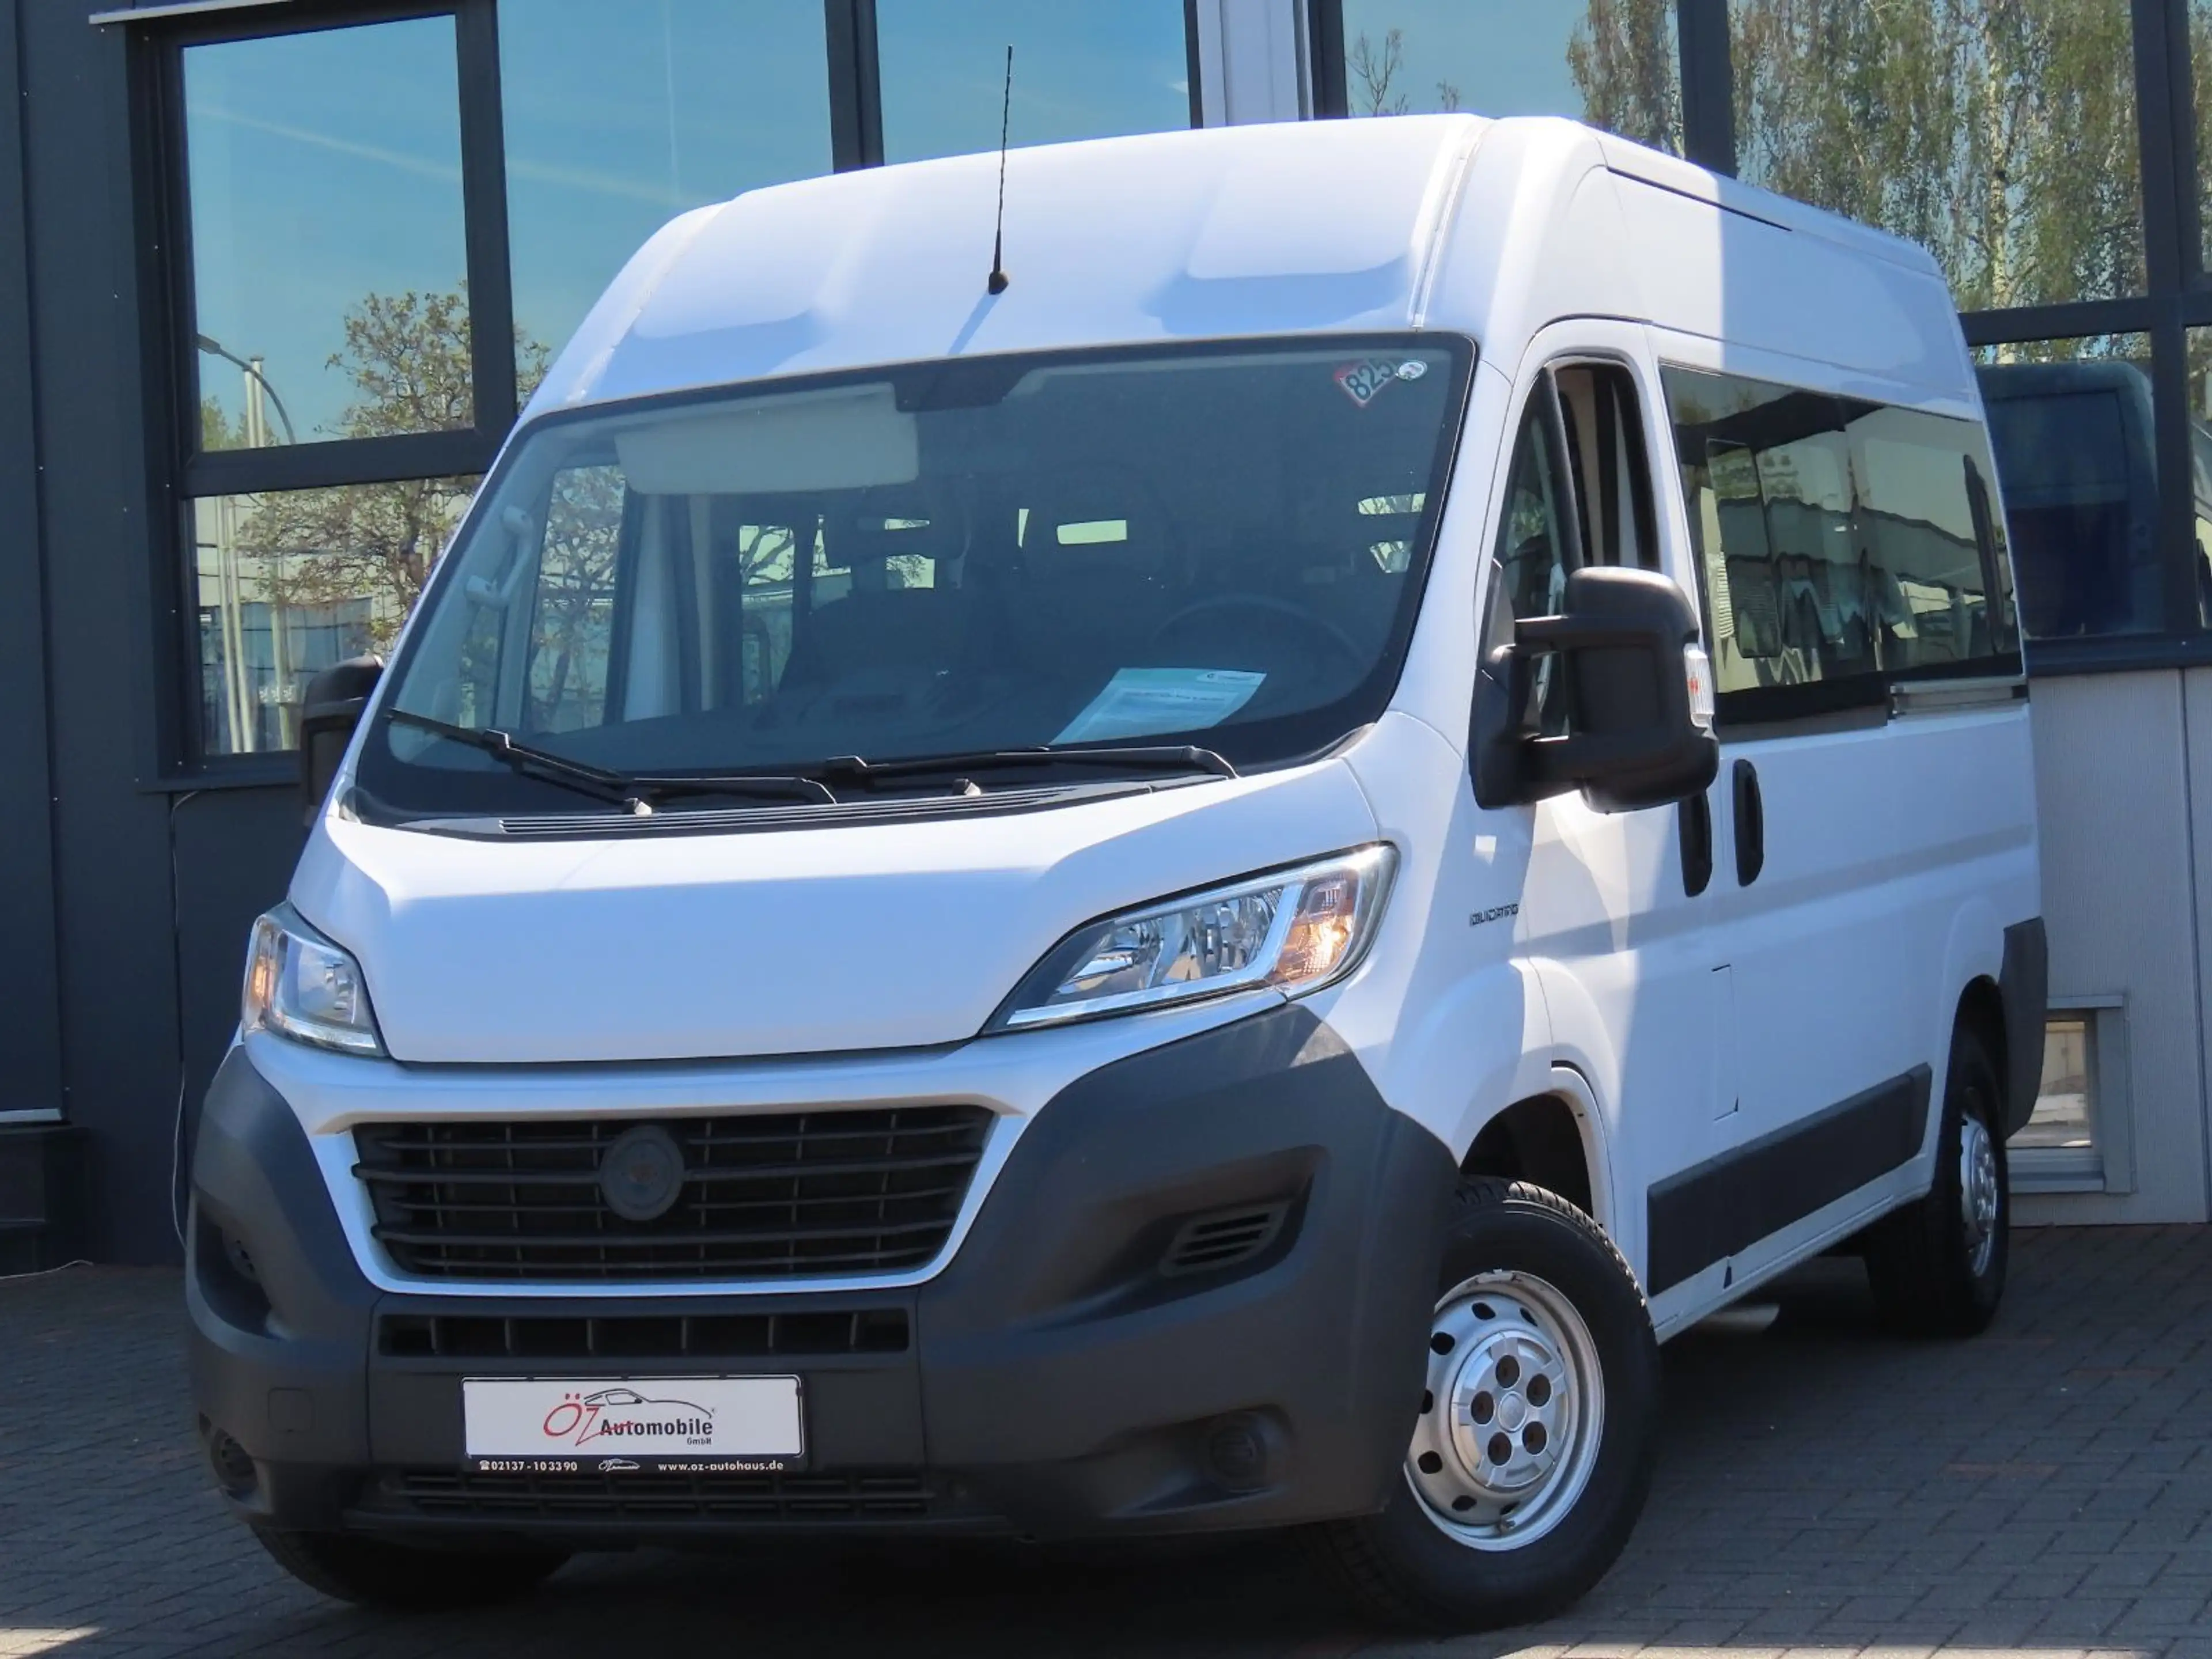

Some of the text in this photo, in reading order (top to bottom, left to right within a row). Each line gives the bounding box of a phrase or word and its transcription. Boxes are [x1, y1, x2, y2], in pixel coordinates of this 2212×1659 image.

[1469, 903, 1519, 926] DUCATO
[543, 1393, 713, 1446] ÖZ Automobile
[658, 1460, 784, 1471] www.oz-autohaus.de
